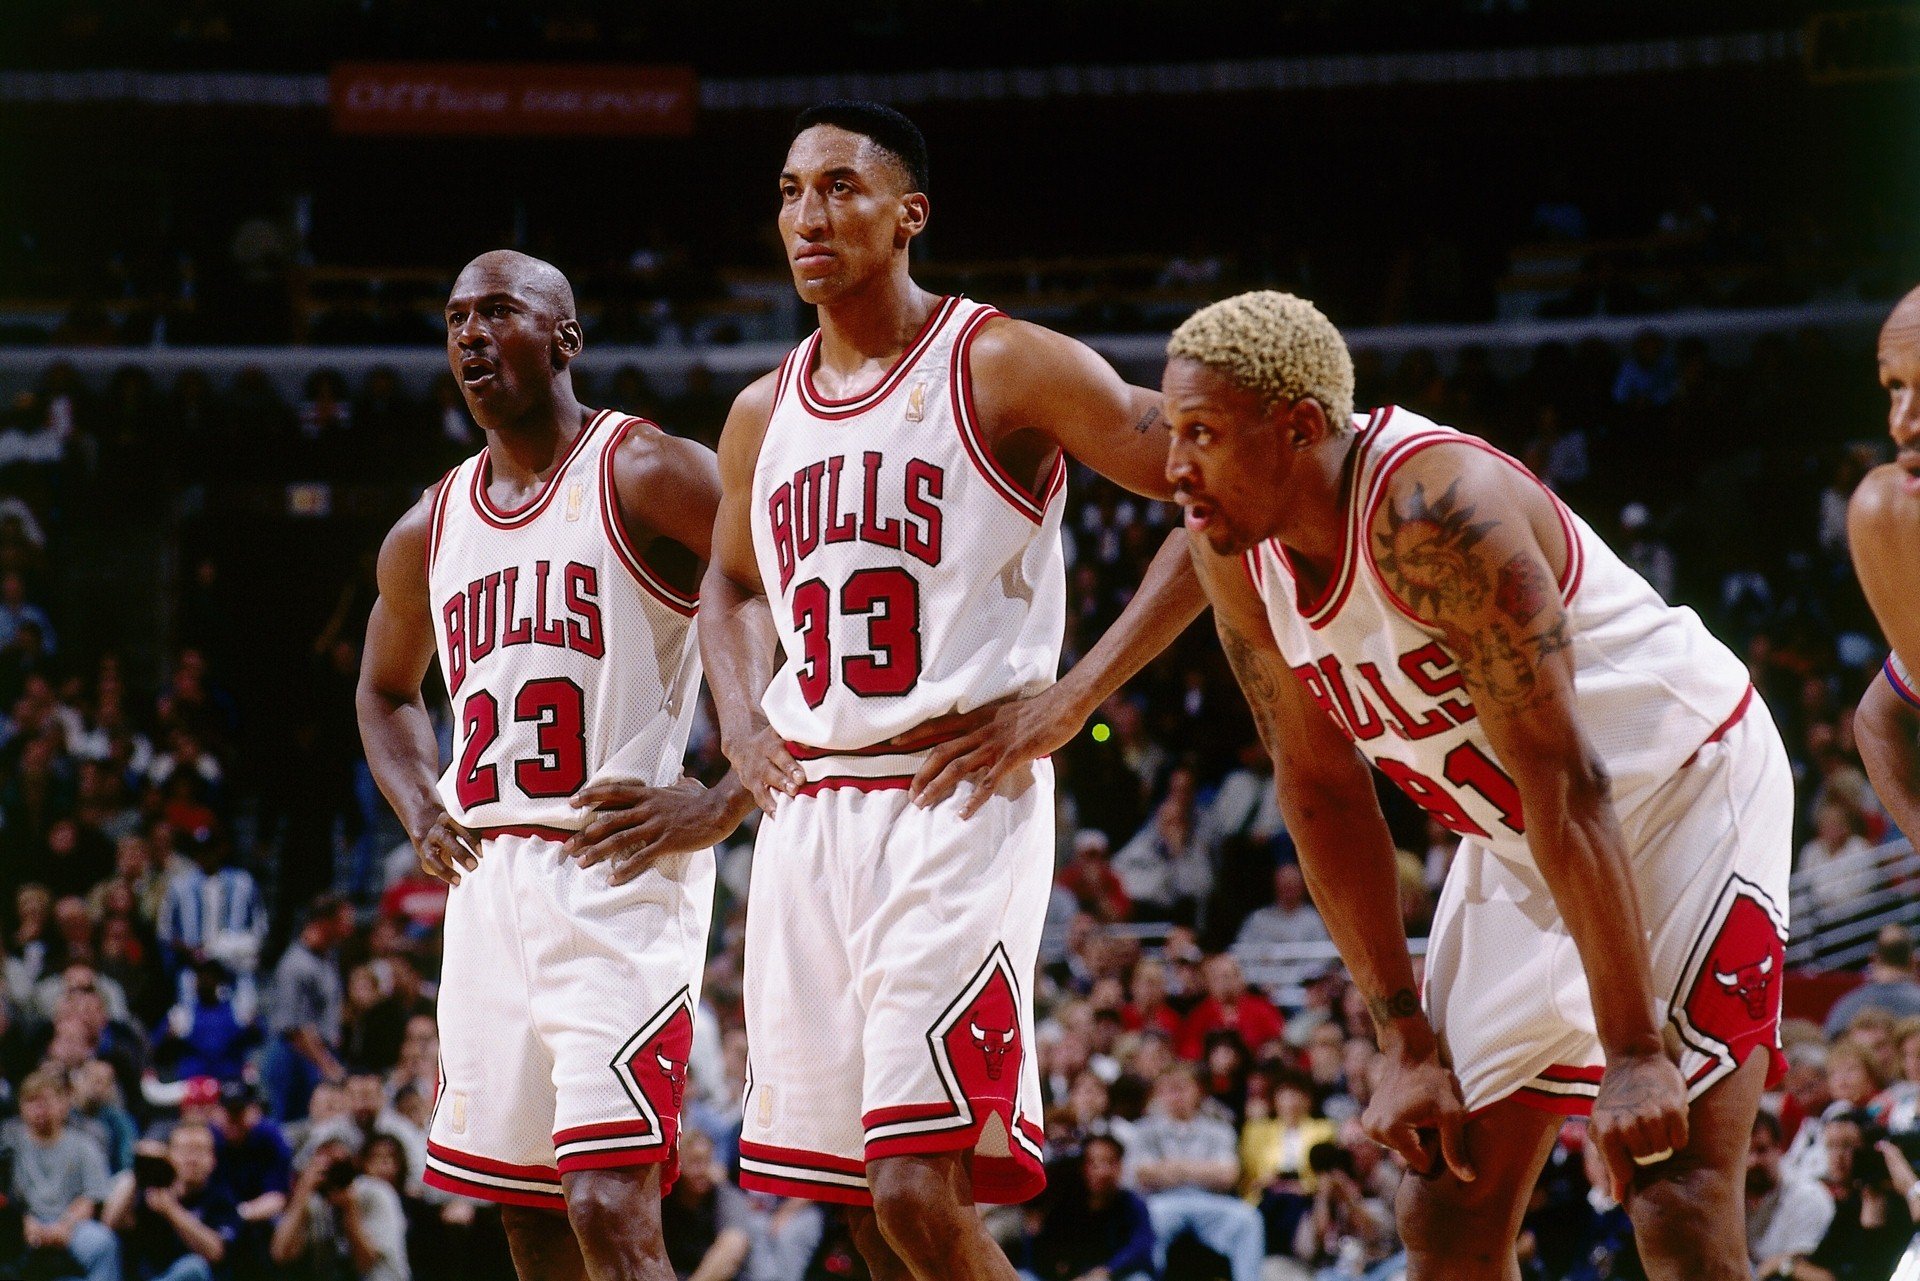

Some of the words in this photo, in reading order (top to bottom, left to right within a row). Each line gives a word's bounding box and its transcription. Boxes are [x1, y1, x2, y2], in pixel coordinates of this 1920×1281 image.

[767, 450, 944, 599] BULLS
[442, 560, 606, 700] BULLS
[792, 565, 921, 711] 33
[455, 676, 588, 814] 23
[1374, 739, 1526, 837] 91
